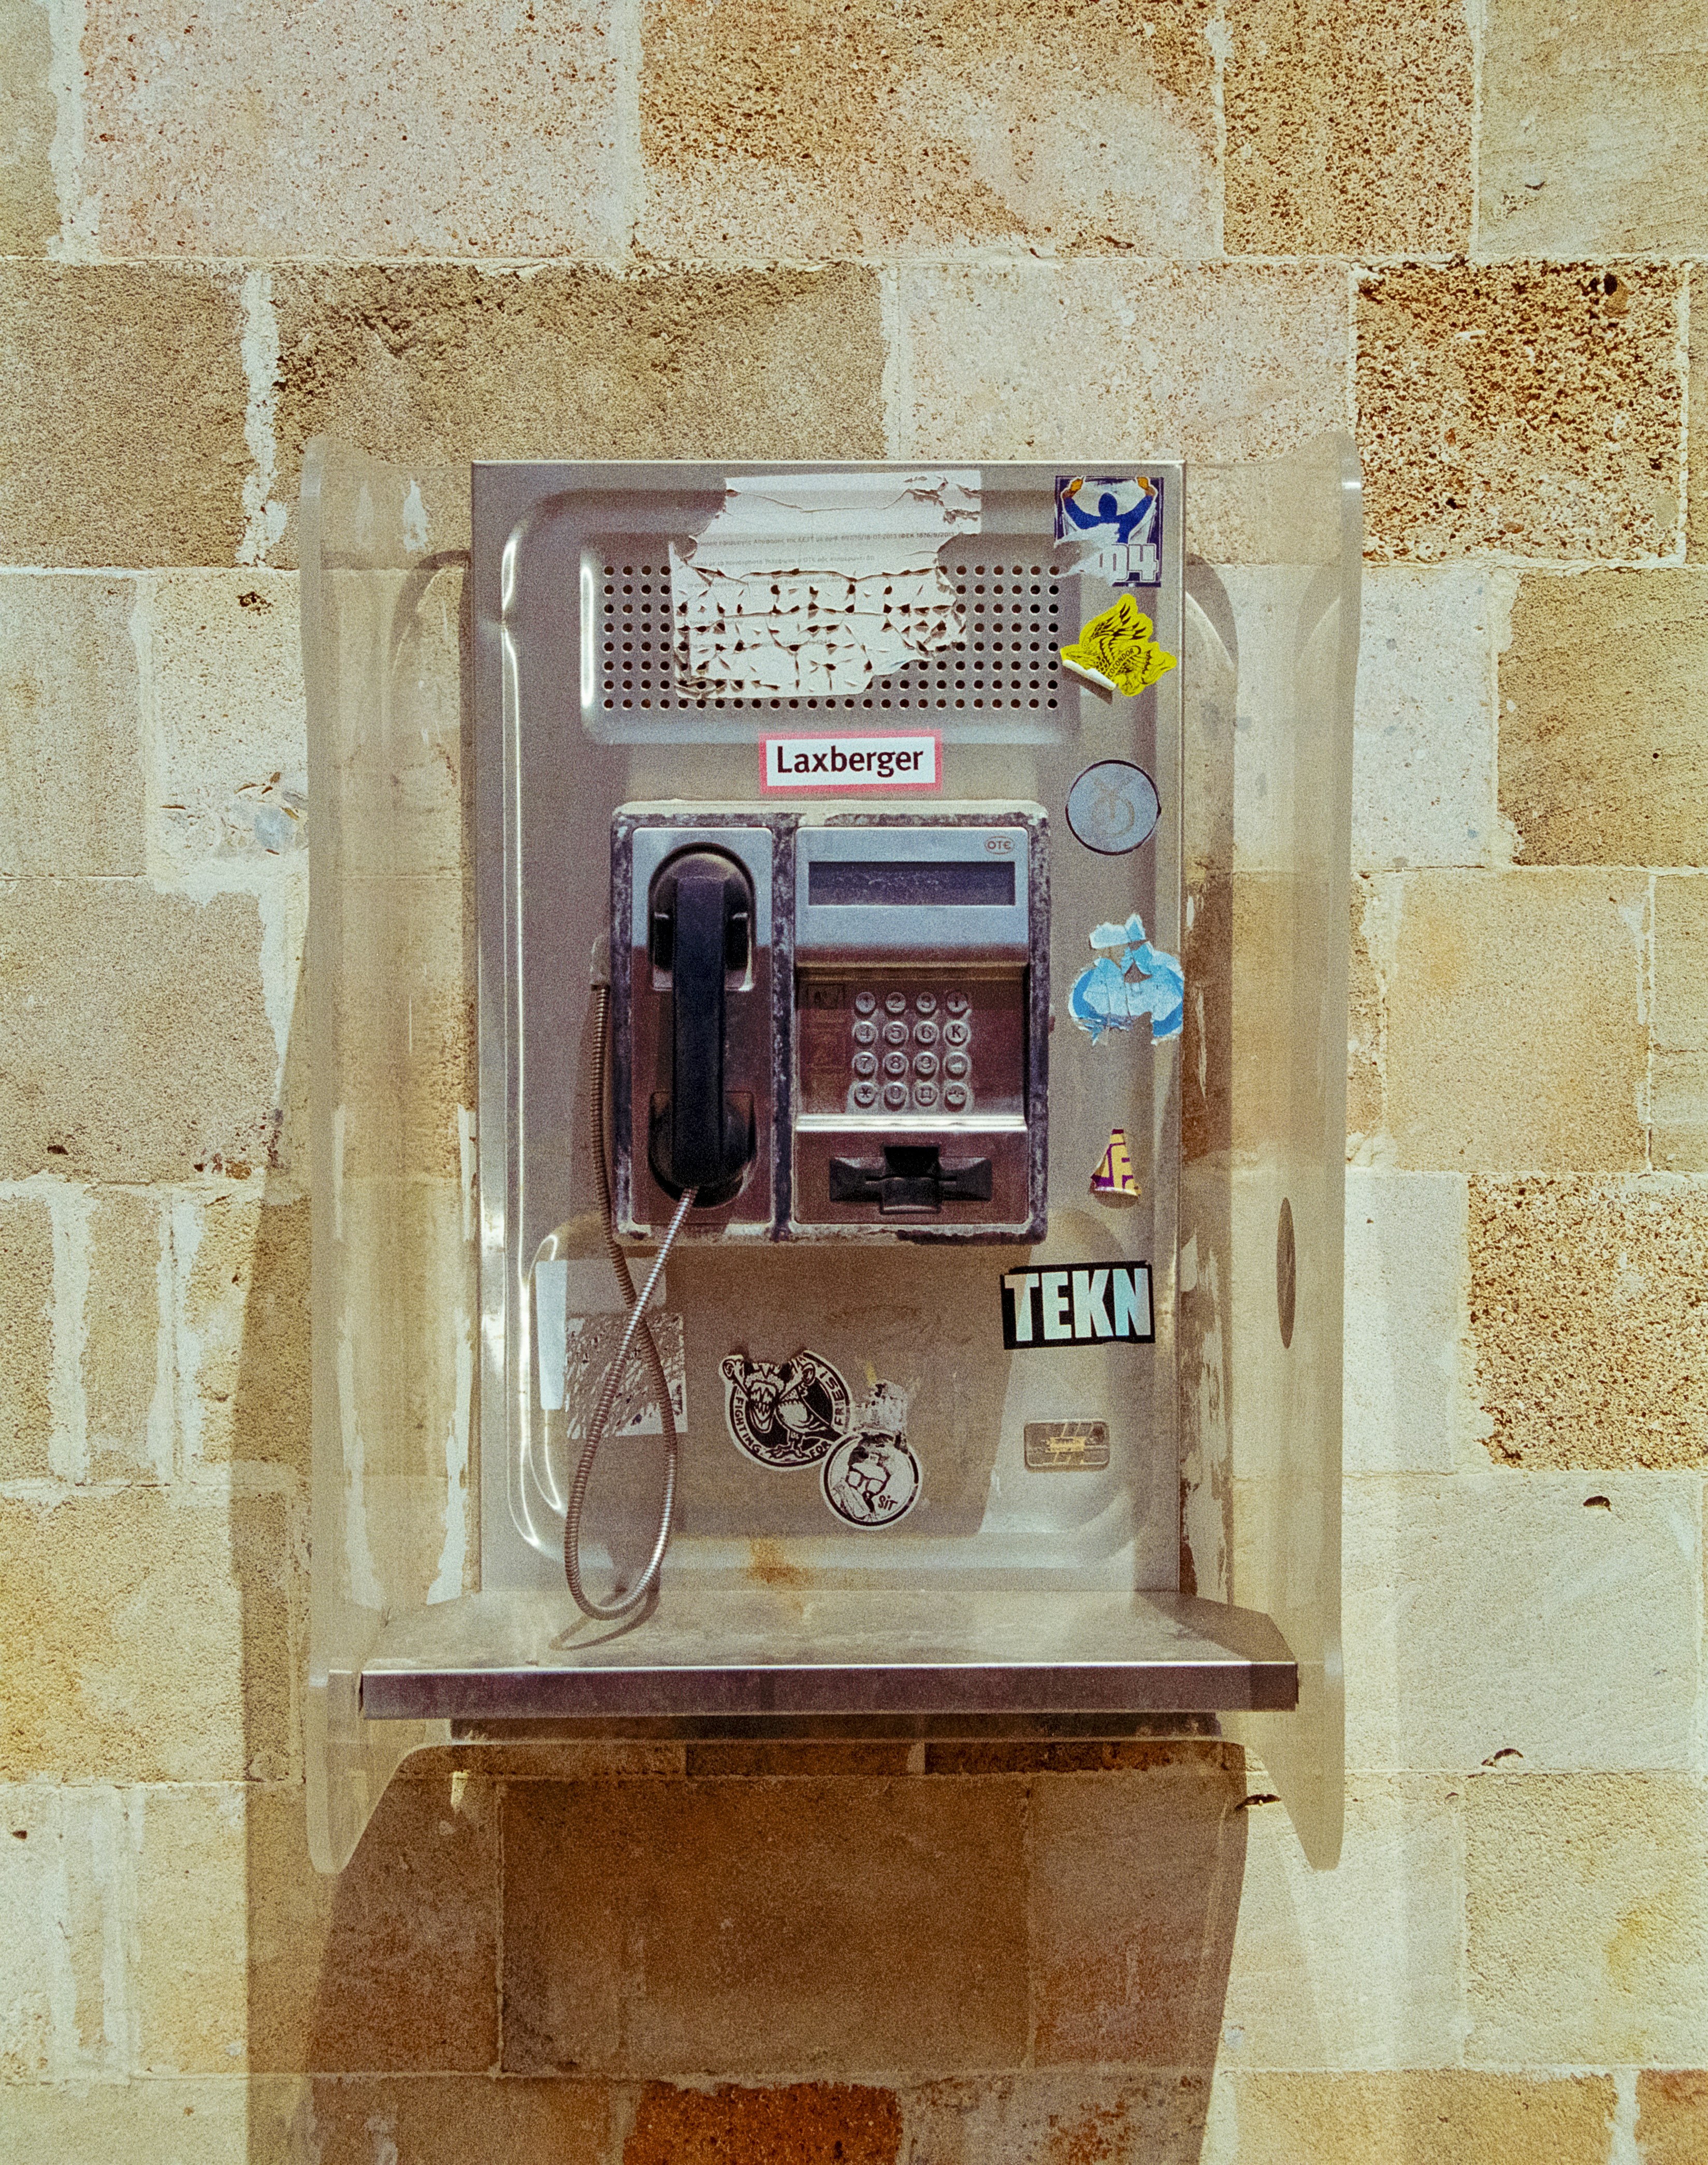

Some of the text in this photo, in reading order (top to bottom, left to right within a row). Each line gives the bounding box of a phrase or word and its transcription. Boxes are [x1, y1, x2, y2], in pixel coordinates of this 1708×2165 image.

[777, 746, 924, 778] Laxberger
[987, 840, 1011, 850] OTE
[1004, 1268, 1151, 1341] TEKN
[734, 1397, 762, 1454] FIGHTING
[809, 1441, 832, 1459] FOR
